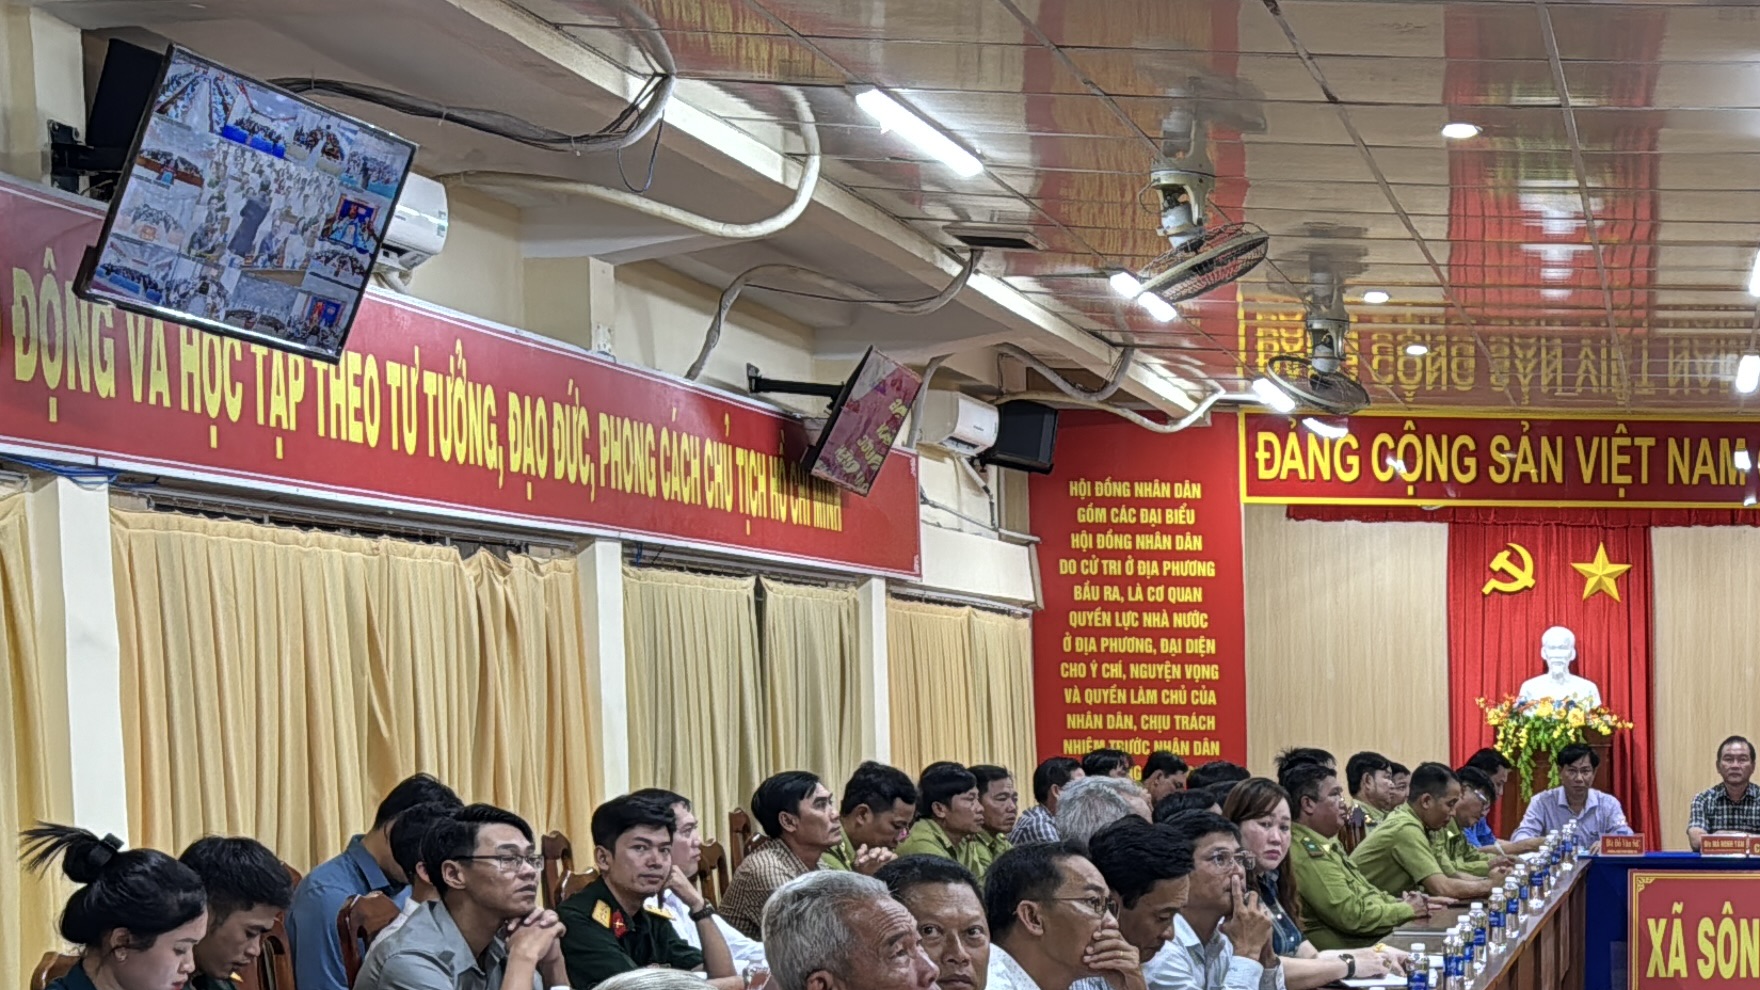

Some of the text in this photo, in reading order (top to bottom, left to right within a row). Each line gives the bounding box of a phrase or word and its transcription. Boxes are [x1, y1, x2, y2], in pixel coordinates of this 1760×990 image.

[12, 247, 116, 423] ĐỘNG
[180, 325, 243, 449] HỌC
[312, 351, 380, 448] THEO
[386, 345, 420, 456] TƯ
[423, 338, 503, 489] TƯỞNG,
[508, 392, 548, 500] ĐẠO
[553, 379, 595, 502] ĐỨC,
[599, 412, 656, 498] PHONG
[660, 406, 702, 506] CÁCH
[704, 412, 733, 513] CHỦ
[736, 446, 767, 536] TỊCH
[1255, 417, 1360, 483] ĐẢNG
[1371, 420, 1476, 496] CỘNG
[1488, 420, 1563, 484] SẢN
[1575, 423, 1656, 498] VIỆT
[1668, 438, 1746, 486] NAM
[1070, 477, 1201, 500] HỘI ĐỒNG NHÂN DÂN
[1077, 503, 1195, 527] GỒM CÁC ĐẠI BIỂU
[1071, 529, 1202, 552] HỘI ĐỒNG NHÂN DÂN
[1059, 555, 1215, 579] DO CỬ TRI Ở ĐỊA PHƯƠNG
[1074, 580, 1202, 604] BẦU RA, LÀ CƠ QUAN
[1069, 607, 1208, 630] QUYỀN LỰC NHÀ NƯỚC
[1063, 631, 1216, 657] Ở ĐỊA PHƯƠNG, ĐẠI DIỆN
[1061, 659, 1219, 683] CHO Ý CHÍ, NGUYỆN VỌNG
[1064, 684, 1216, 705] VÀ QUYỀN LÀM CHỦ CỦA
[1067, 711, 1215, 733] NHÂN DÂN, CHỊU TRÁCH
[1194, 738, 1220, 756] DÂN
[1646, 901, 1688, 978] XÃ
